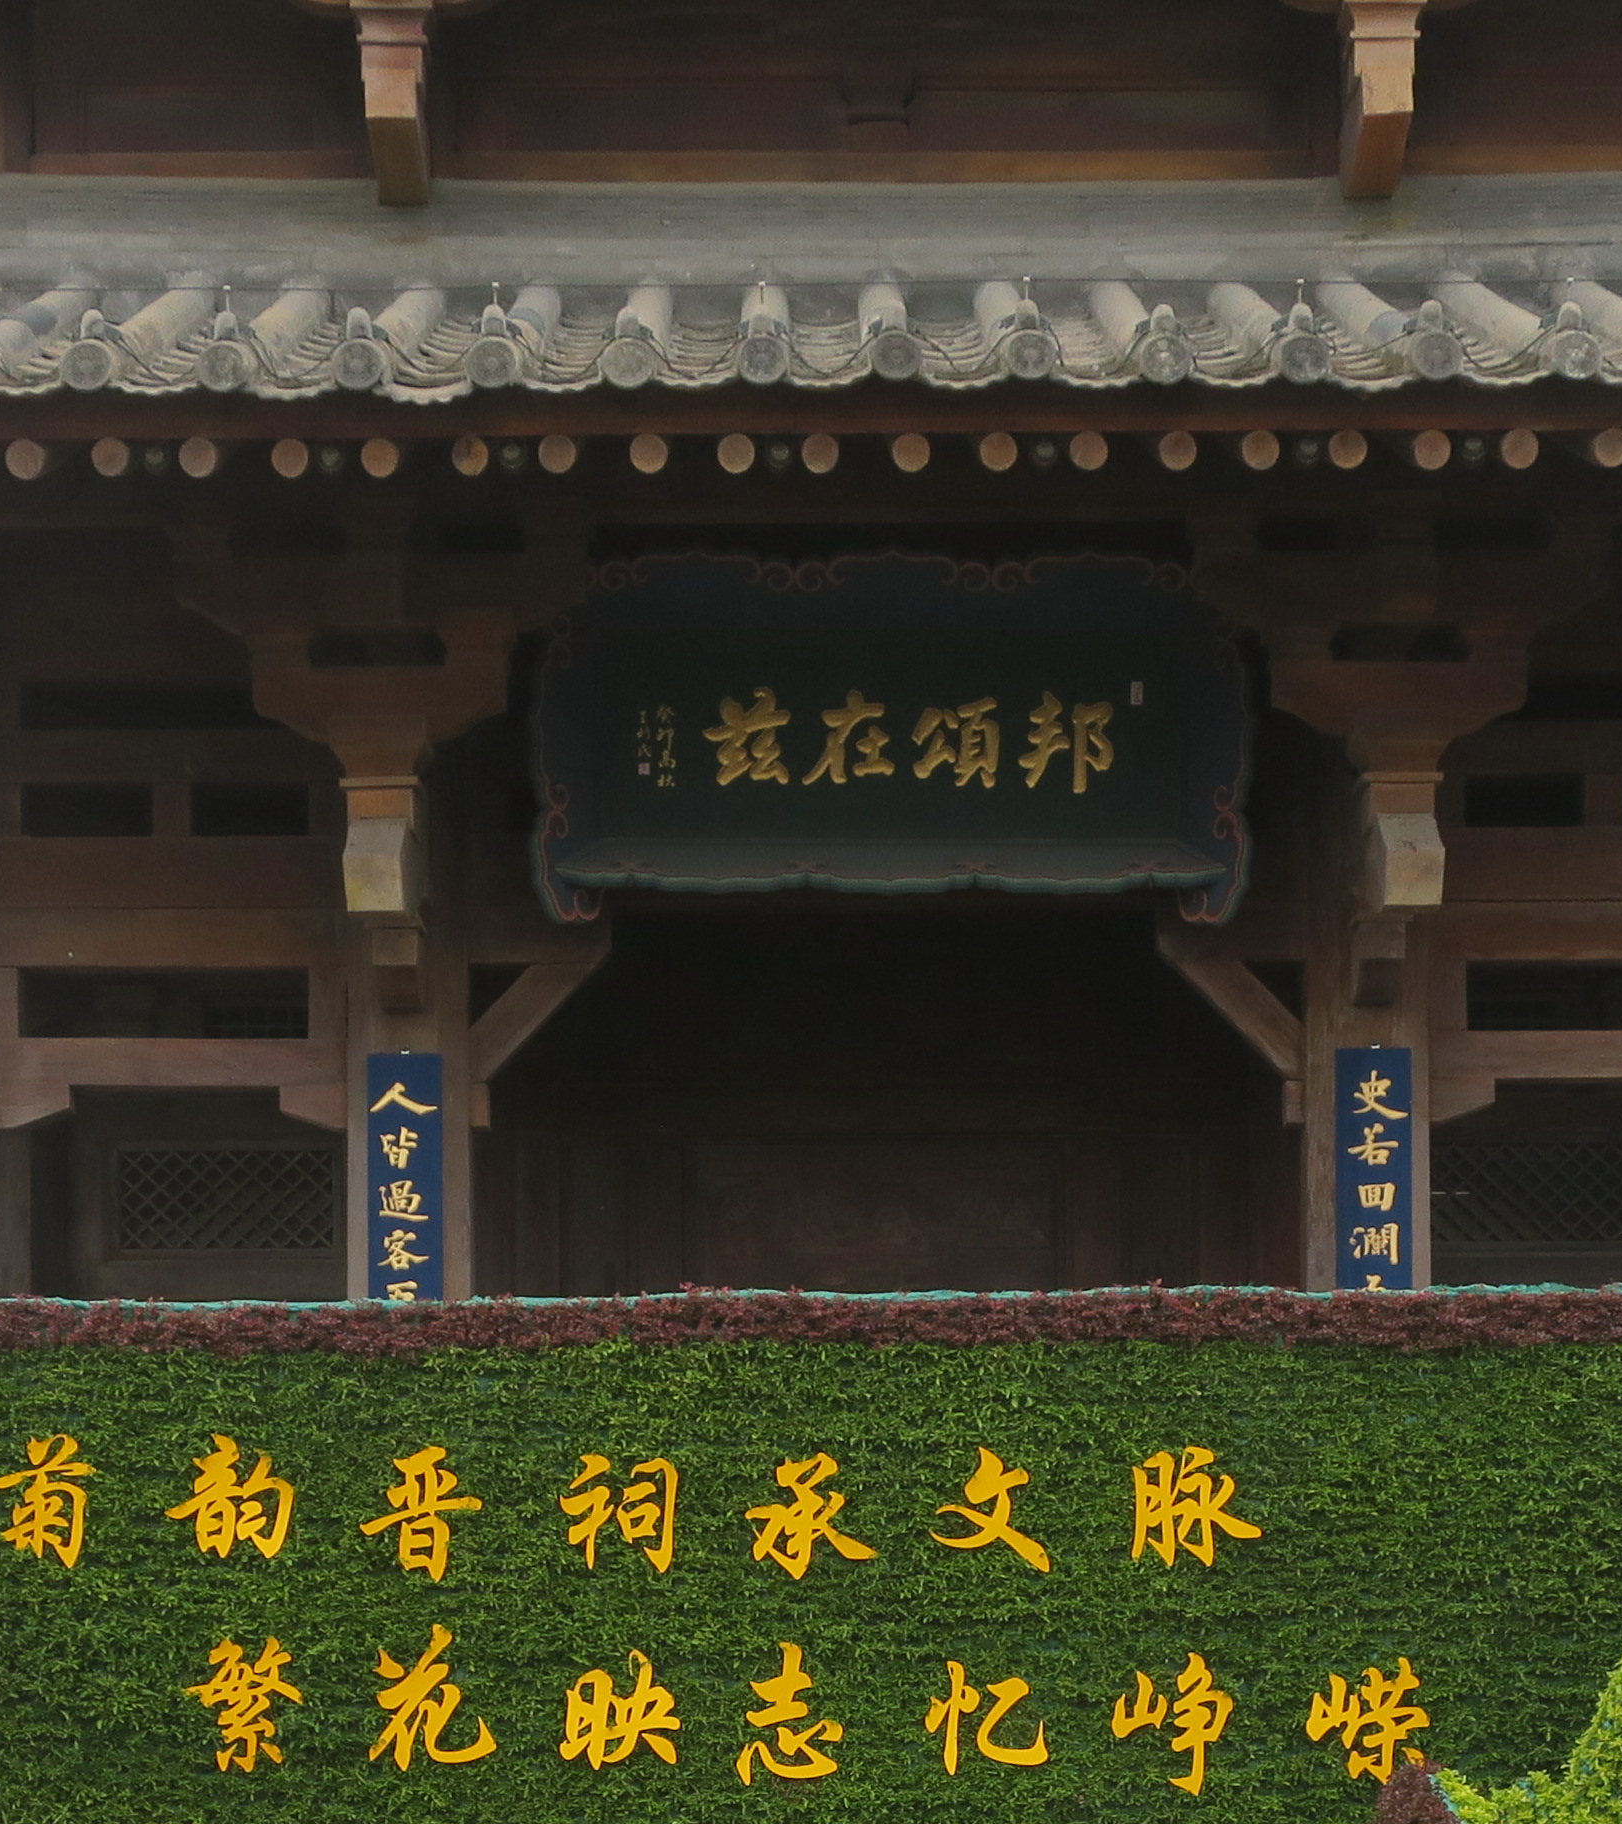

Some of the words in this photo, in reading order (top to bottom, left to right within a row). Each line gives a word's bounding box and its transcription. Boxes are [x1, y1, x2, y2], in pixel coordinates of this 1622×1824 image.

[182, 1623, 1432, 1796] 繁花映志忆峥嵘
